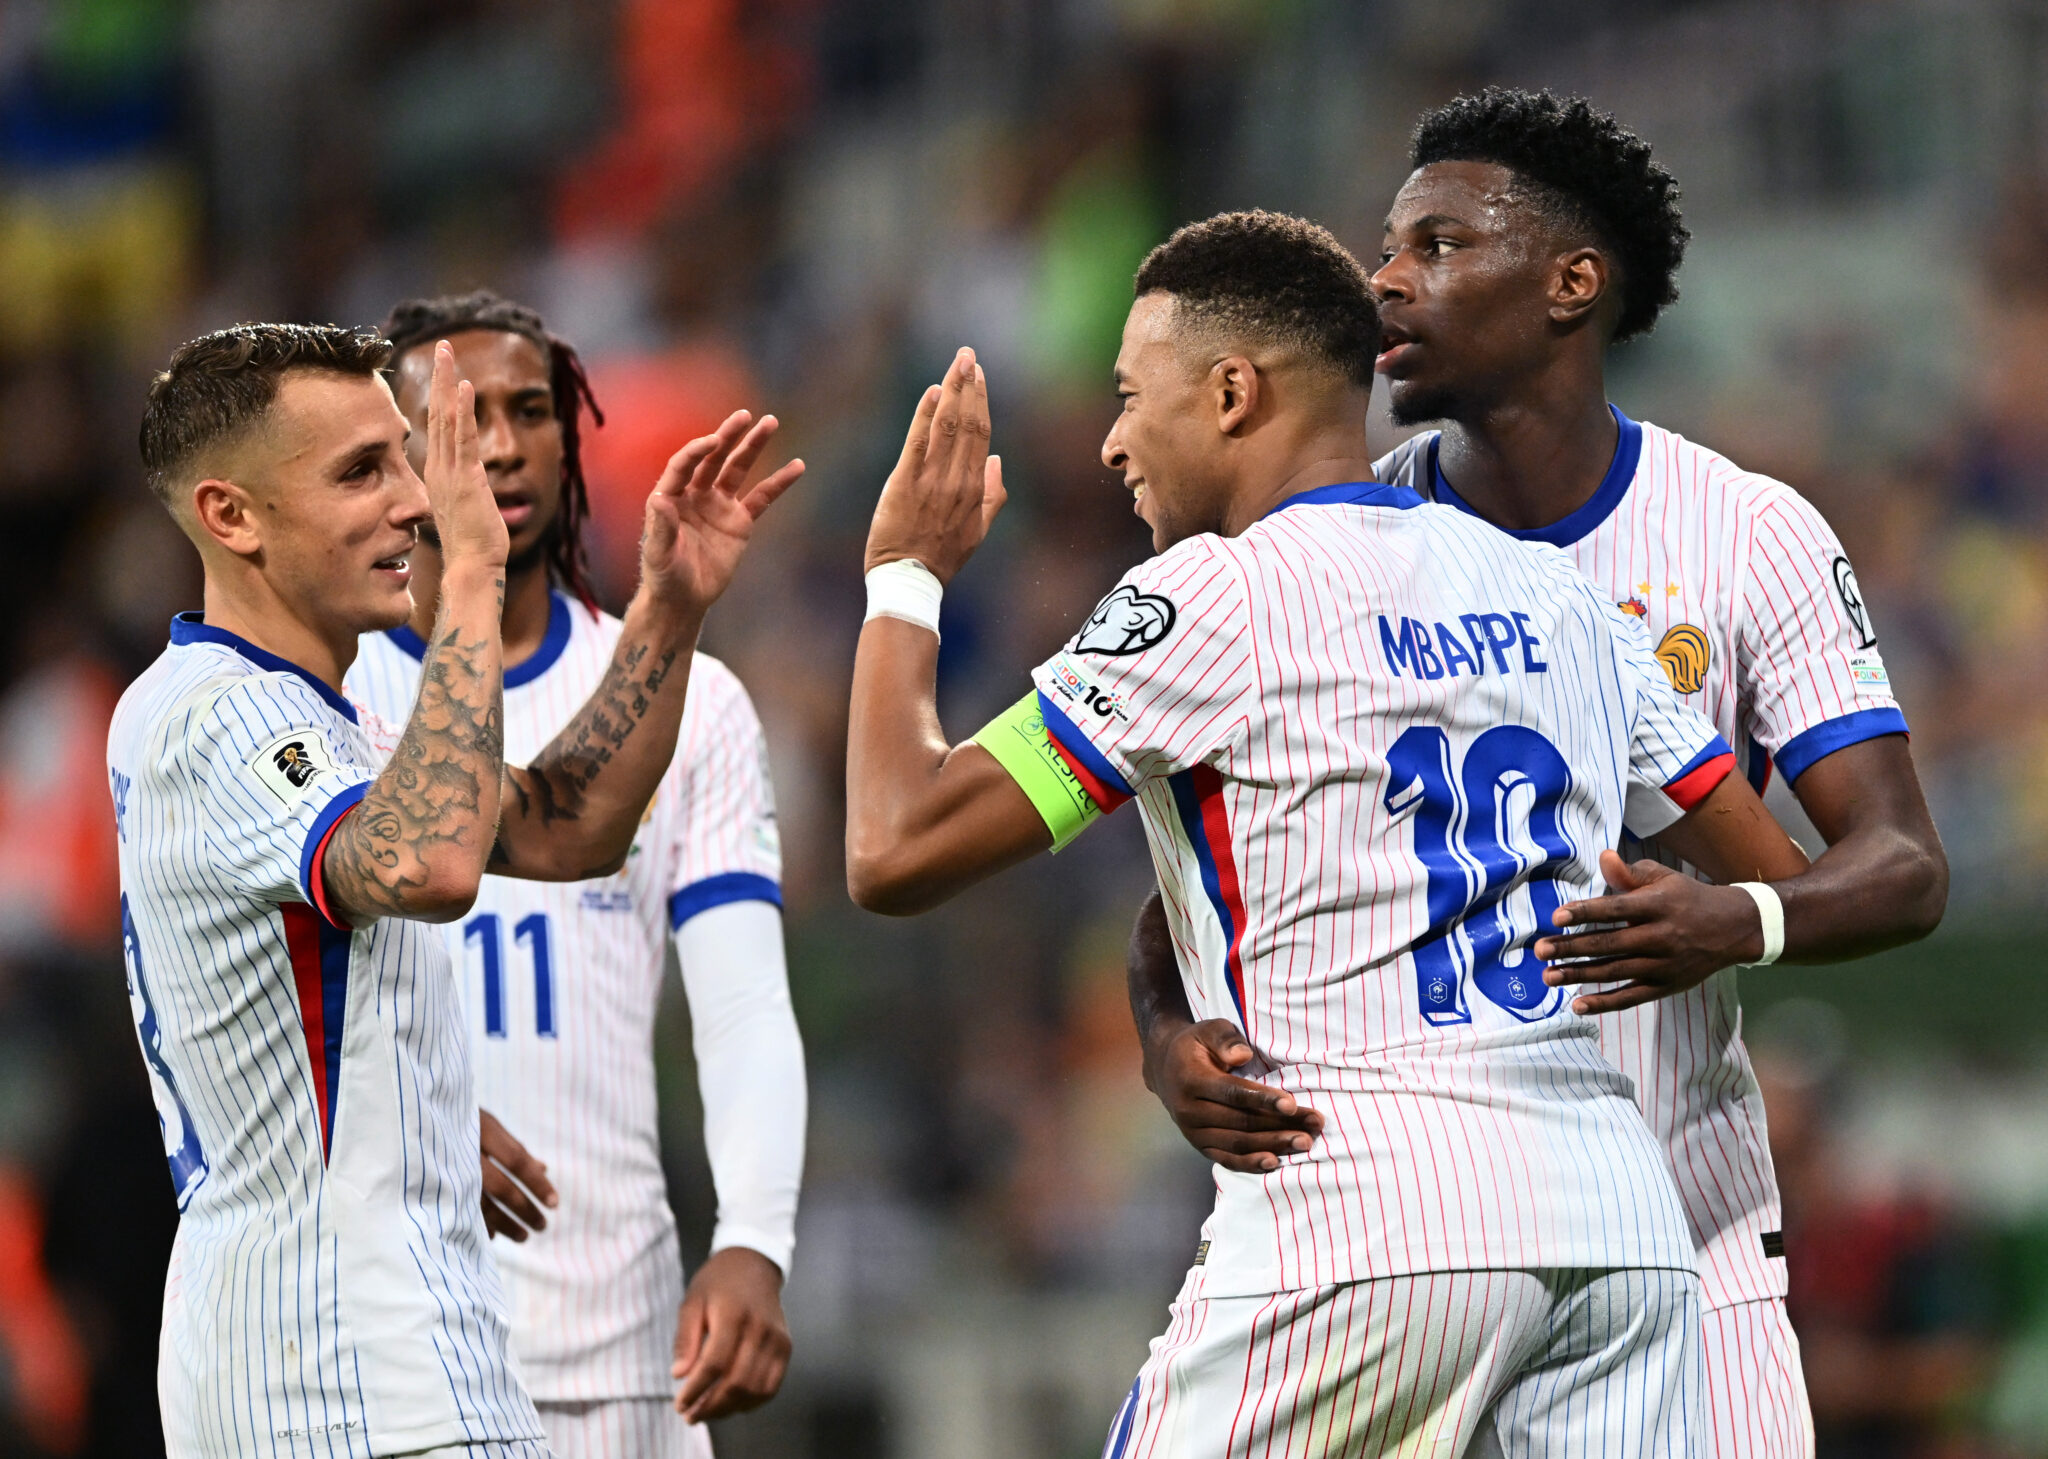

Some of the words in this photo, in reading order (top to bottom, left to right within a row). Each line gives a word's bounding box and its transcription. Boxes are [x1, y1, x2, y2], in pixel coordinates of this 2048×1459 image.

[1378, 611, 1547, 680] MBAPPE
[1383, 724, 1577, 1027] 10
[464, 911, 559, 1040] 11
